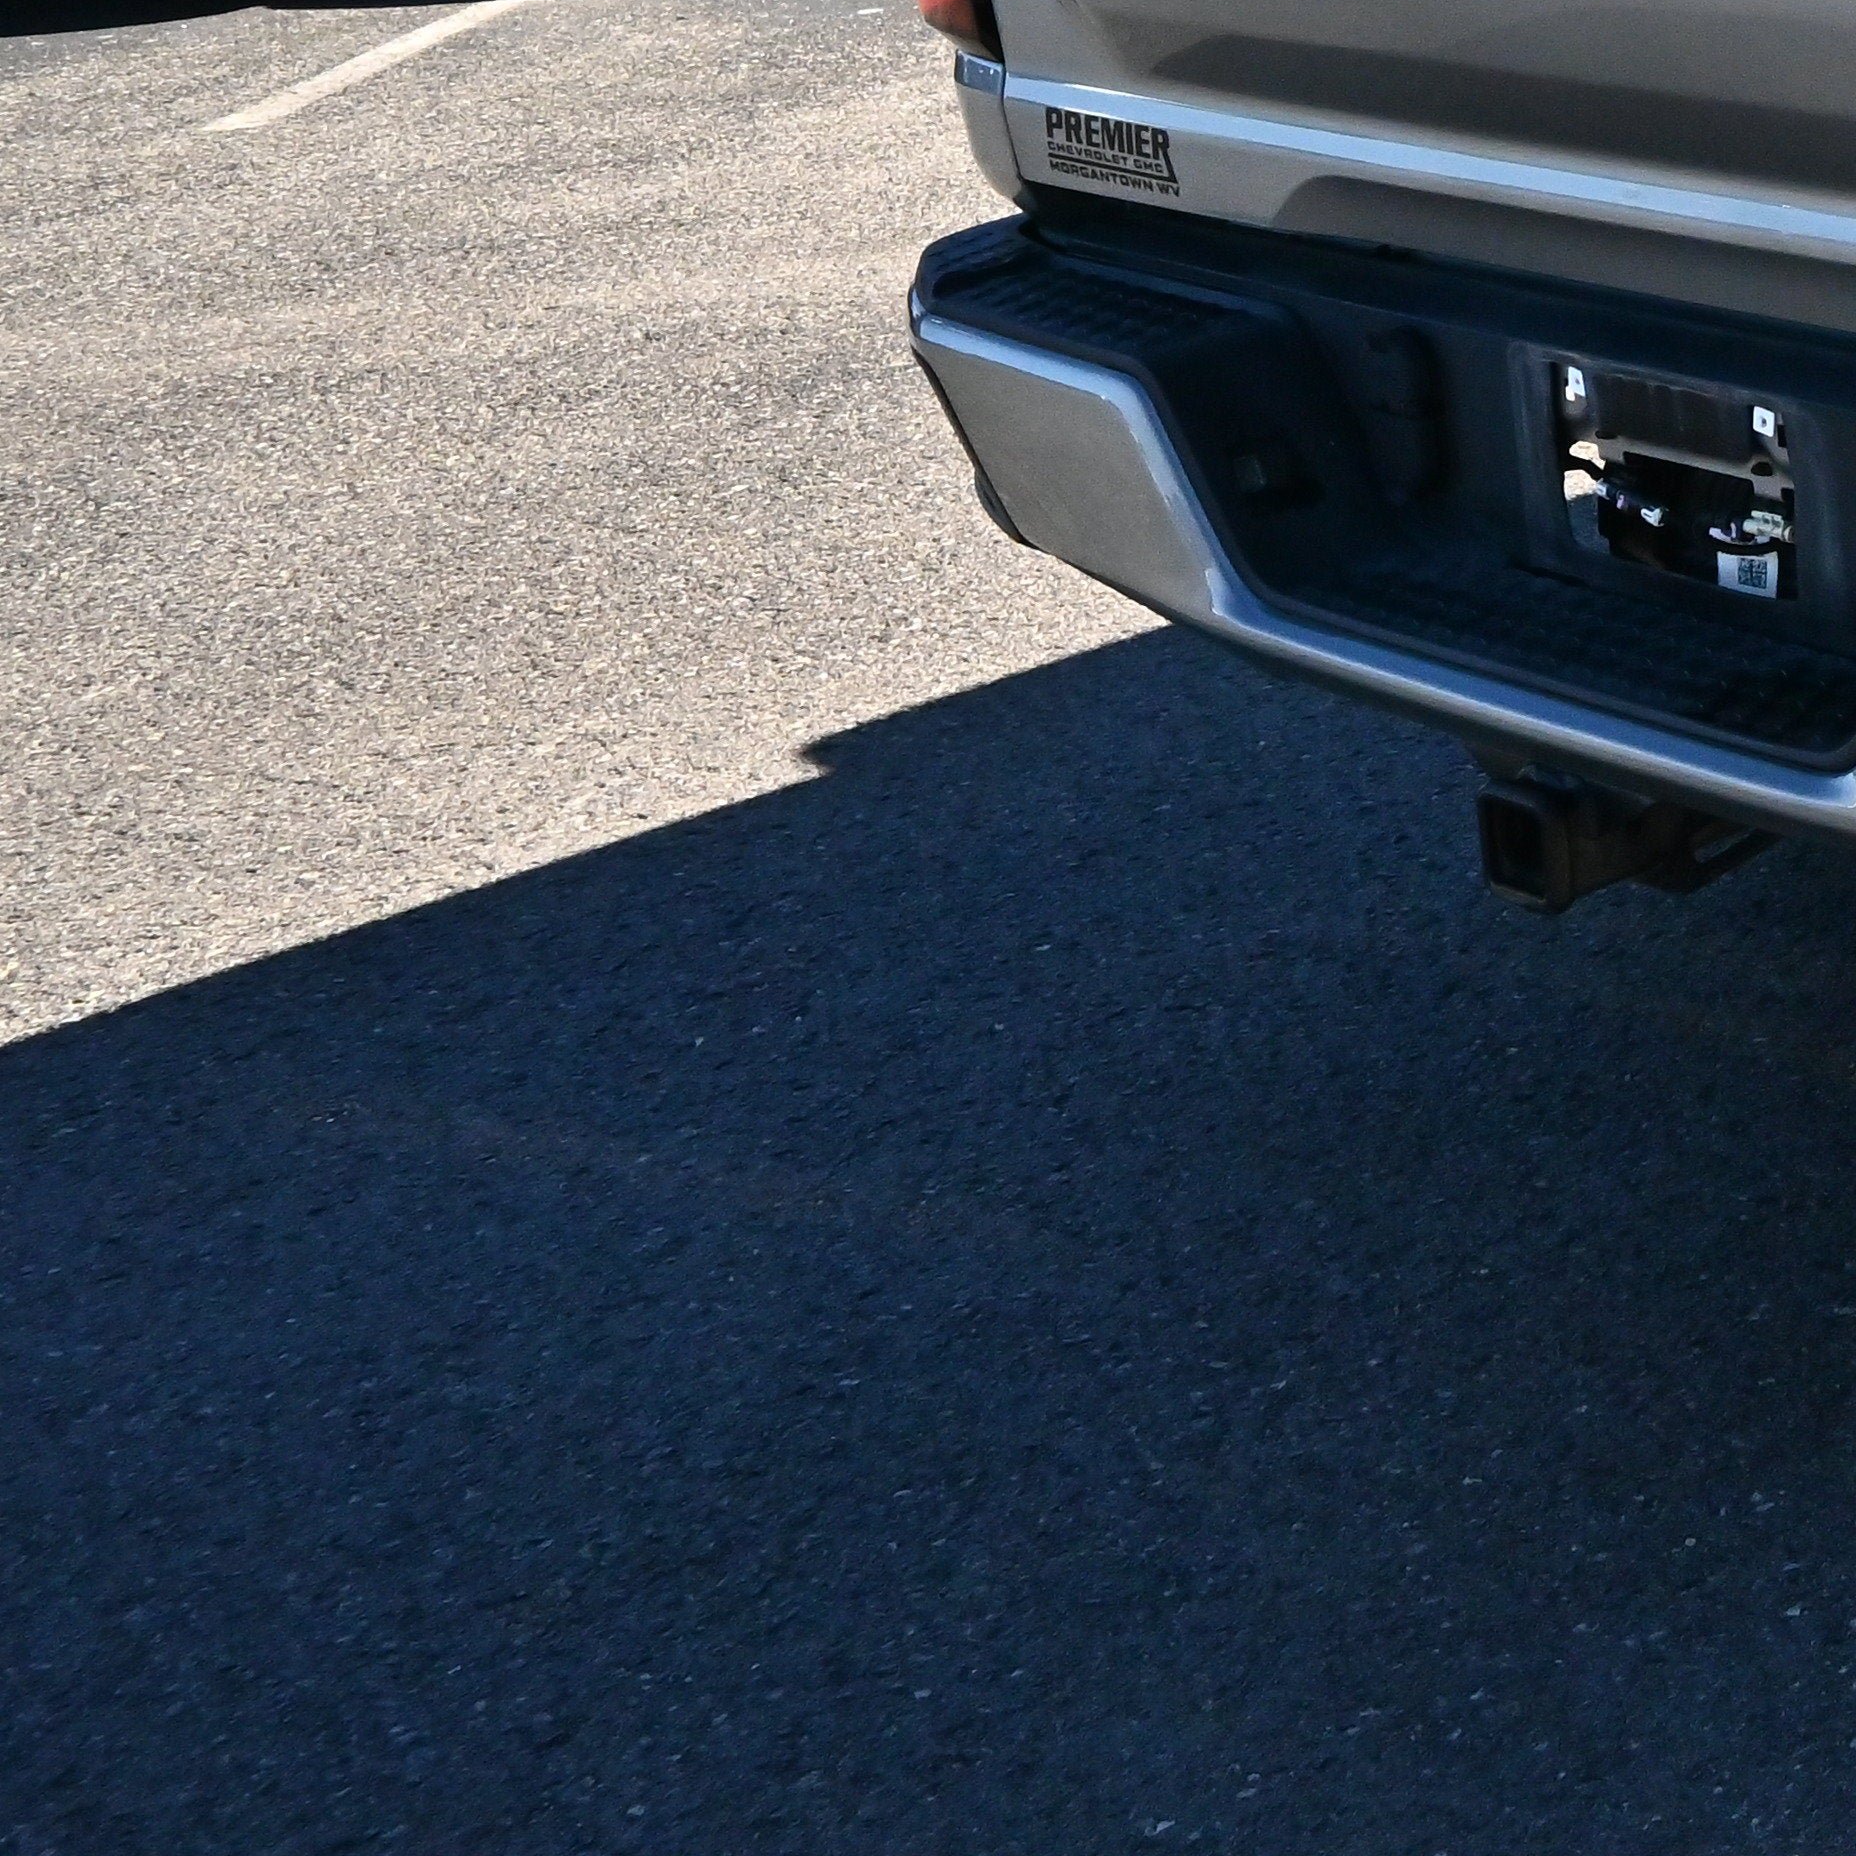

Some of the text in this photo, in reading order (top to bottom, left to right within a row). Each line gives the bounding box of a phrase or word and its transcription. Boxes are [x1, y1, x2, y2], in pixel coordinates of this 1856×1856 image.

[1045, 106, 1172, 164] PREMIER
[1047, 141, 1164, 174] CHEVROLET GMC
[1049, 160, 1180, 197] MORGANTOWN WV
